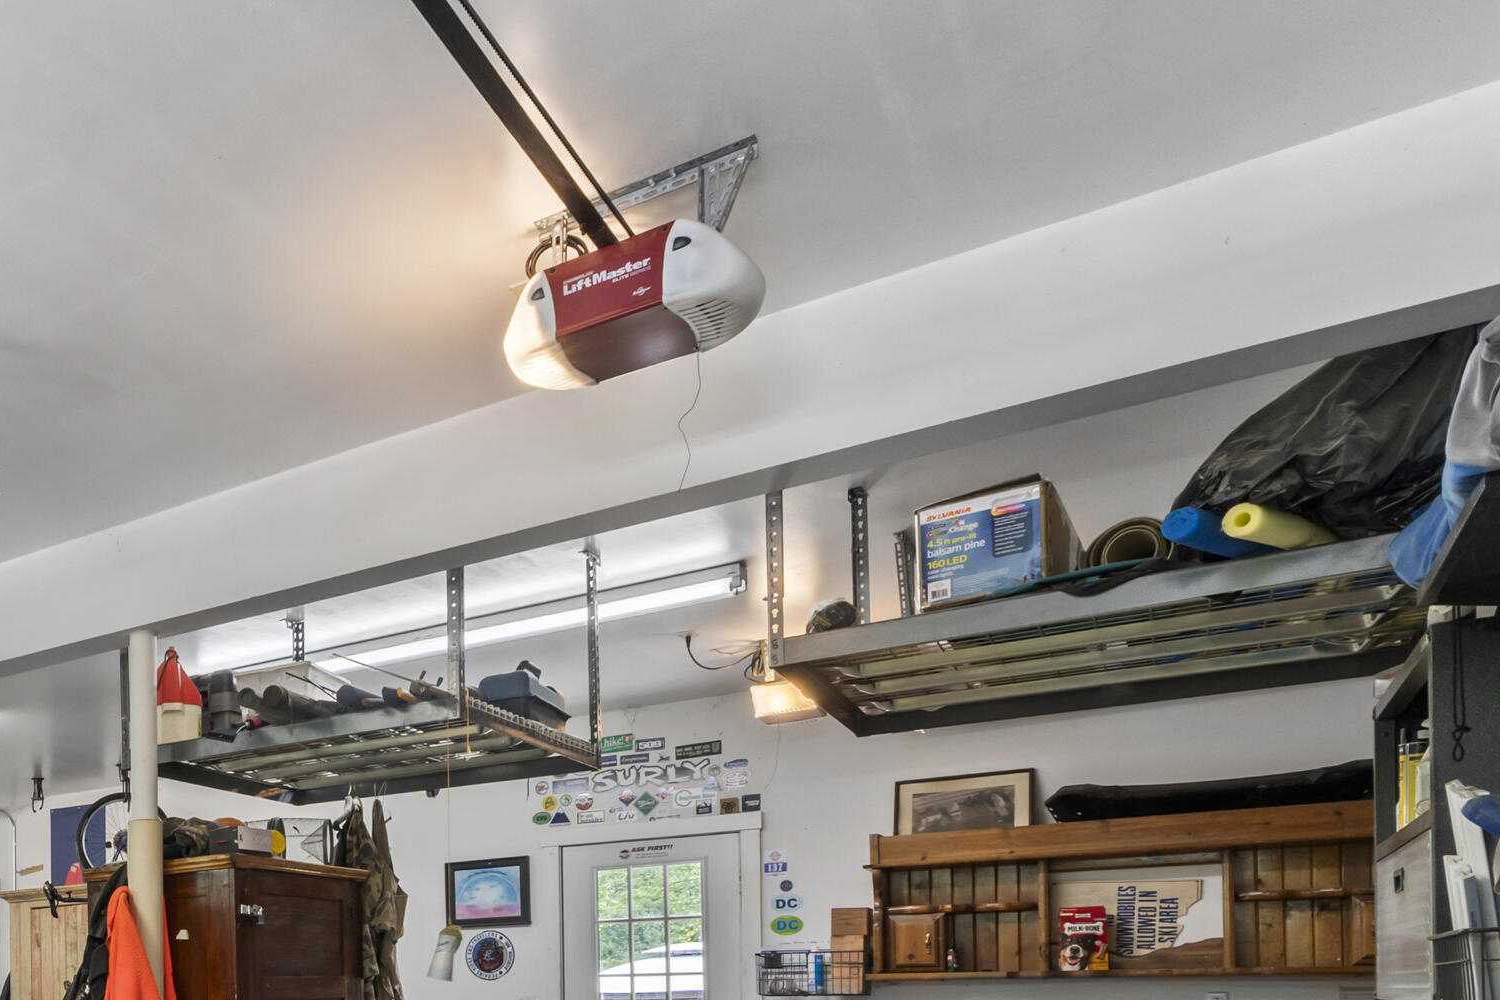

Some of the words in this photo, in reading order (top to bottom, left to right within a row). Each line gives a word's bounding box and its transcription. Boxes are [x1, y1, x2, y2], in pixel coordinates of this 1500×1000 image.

[563, 257, 651, 296] LiftMaster
[927, 545, 962, 558] balsam
[964, 539, 986, 551] pine
[928, 560, 945, 569] 160
[946, 554, 968, 566] LED
[591, 758, 710, 793] SURLY
[775, 898, 798, 909] DC
[1138, 890, 1157, 902] IN
[1159, 897, 1179, 924] AREA
[776, 920, 799, 931] DC
[1116, 886, 1136, 955] SNOWMOBILES
[1136, 906, 1157, 950] ALLOWED
[1158, 926, 1178, 943] SKI
